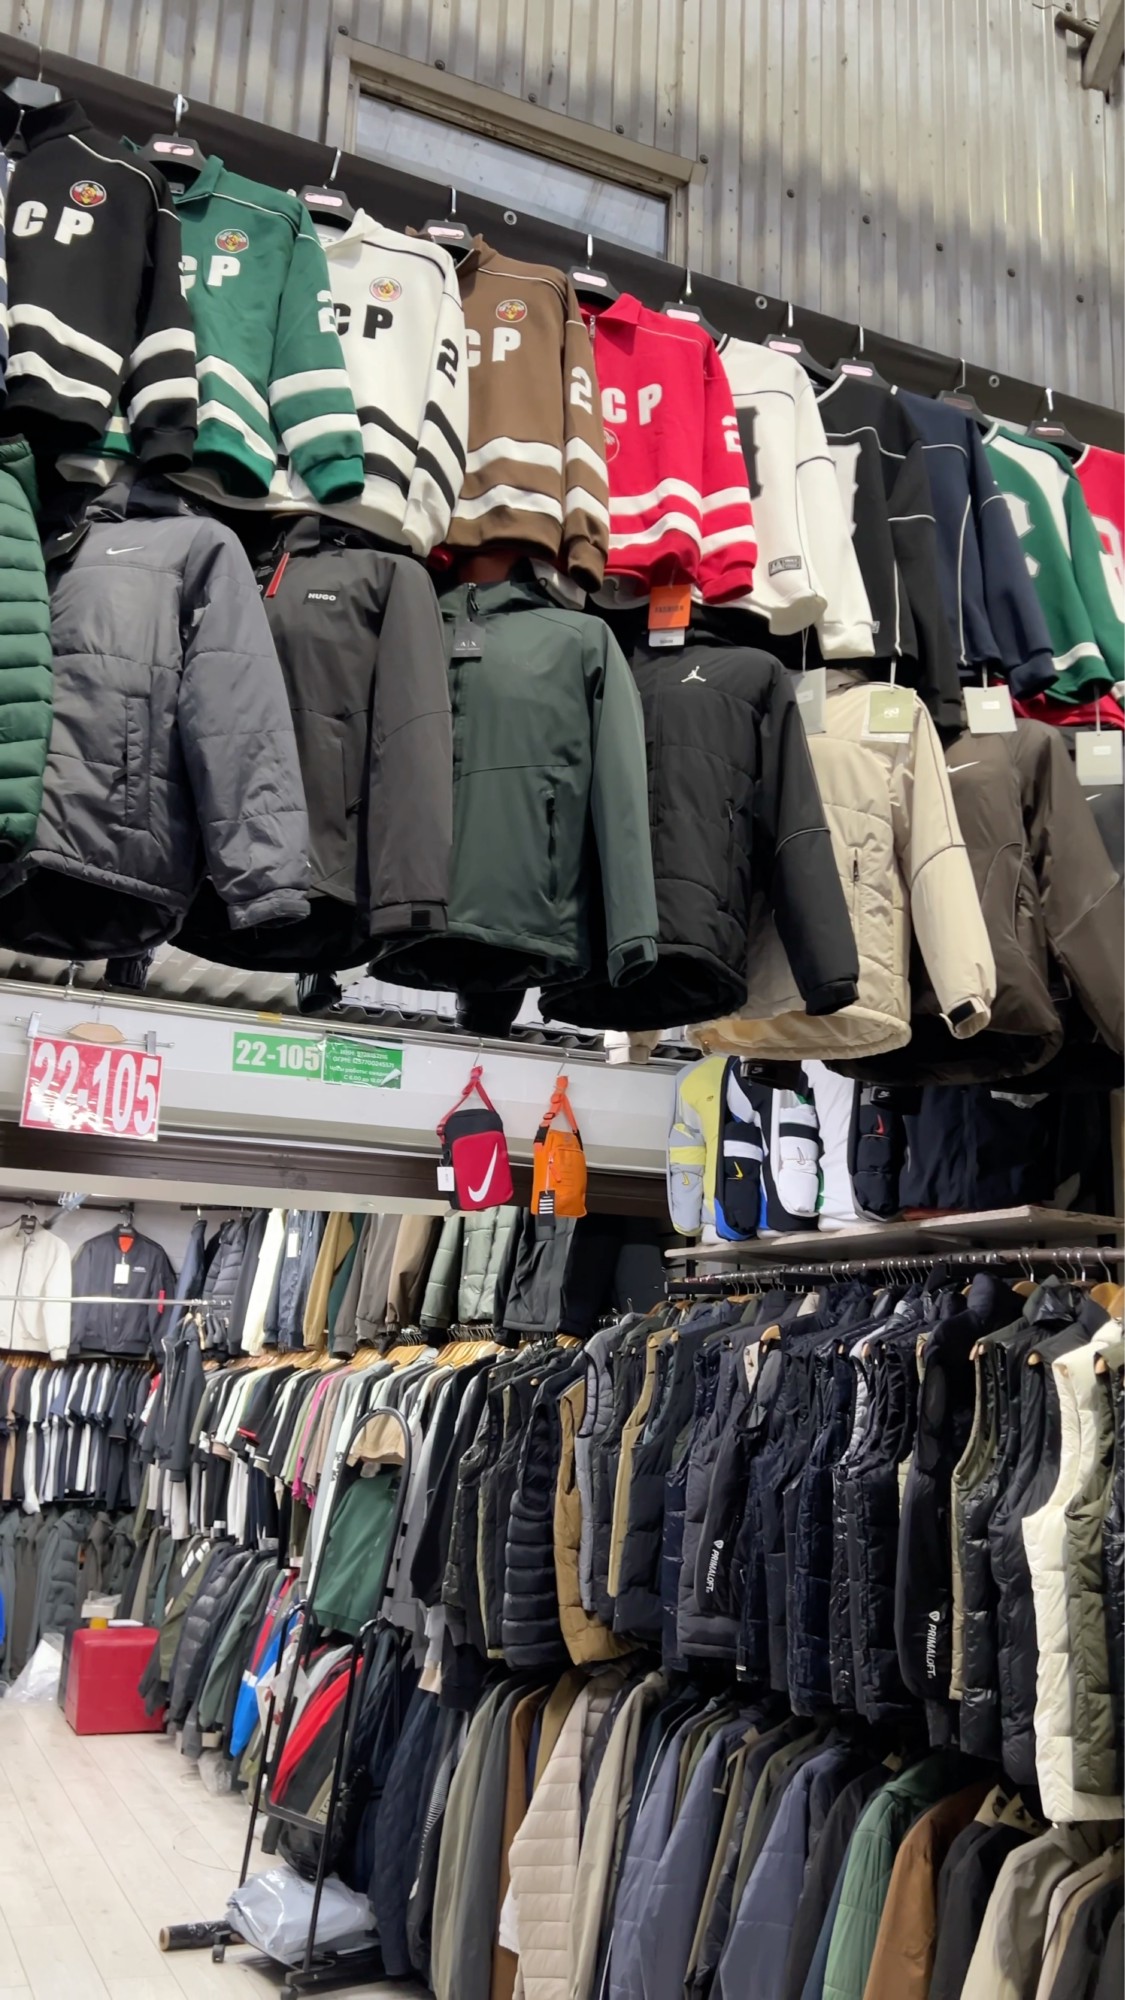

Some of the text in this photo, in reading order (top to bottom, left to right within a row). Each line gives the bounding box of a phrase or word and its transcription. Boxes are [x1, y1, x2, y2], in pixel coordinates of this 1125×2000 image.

[436, 338, 459, 388] 2
[570, 366, 593, 415] 2
[307, 592, 337, 601] HUGO
[235, 1039, 320, 1071] 22-105
[26, 1042, 159, 1135] 22-105
